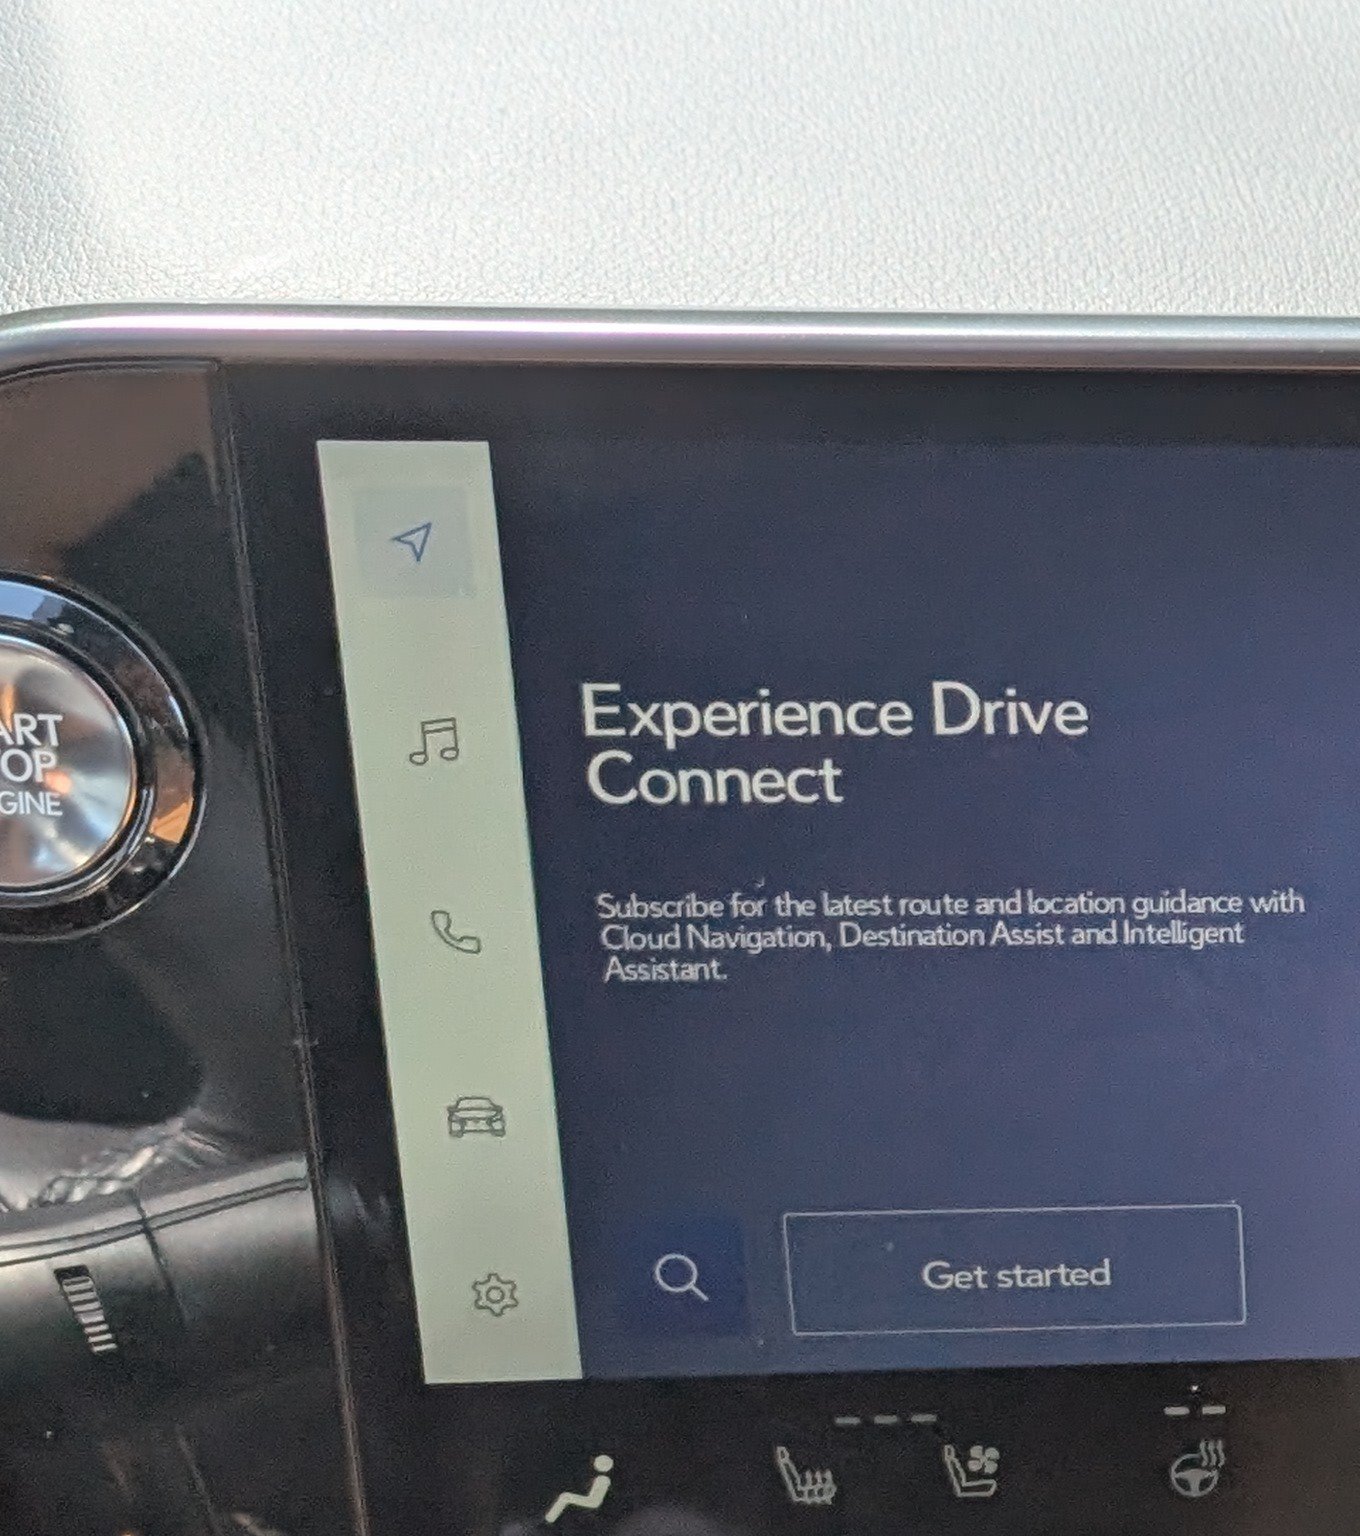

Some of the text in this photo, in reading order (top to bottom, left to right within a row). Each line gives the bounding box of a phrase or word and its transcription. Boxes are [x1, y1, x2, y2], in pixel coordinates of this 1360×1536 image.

[580, 680, 1090, 749] Experience Drive
[586, 749, 844, 804] Connect
[598, 887, 1306, 920] Subscribe for the latest route and location guidance with
[600, 919, 1246, 955] Cloud Navigation, Destination Assist and Intelligent
[603, 955, 728, 985] Assistant.
[921, 1257, 1113, 1292] Get started
